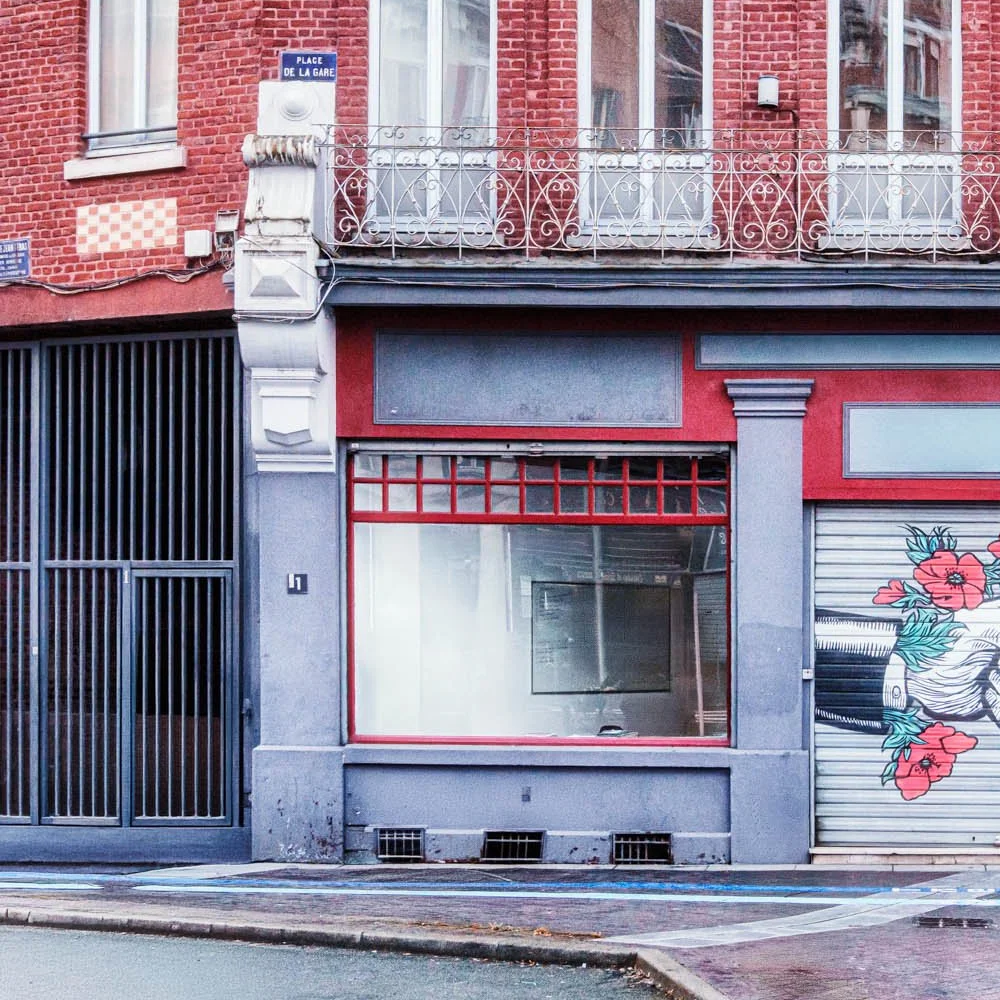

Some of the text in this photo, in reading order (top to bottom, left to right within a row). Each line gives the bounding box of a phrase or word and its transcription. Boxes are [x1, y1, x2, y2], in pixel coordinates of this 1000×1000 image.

[296, 56, 323, 65] PLACE
[283, 67, 335, 77] DE LA GARE
